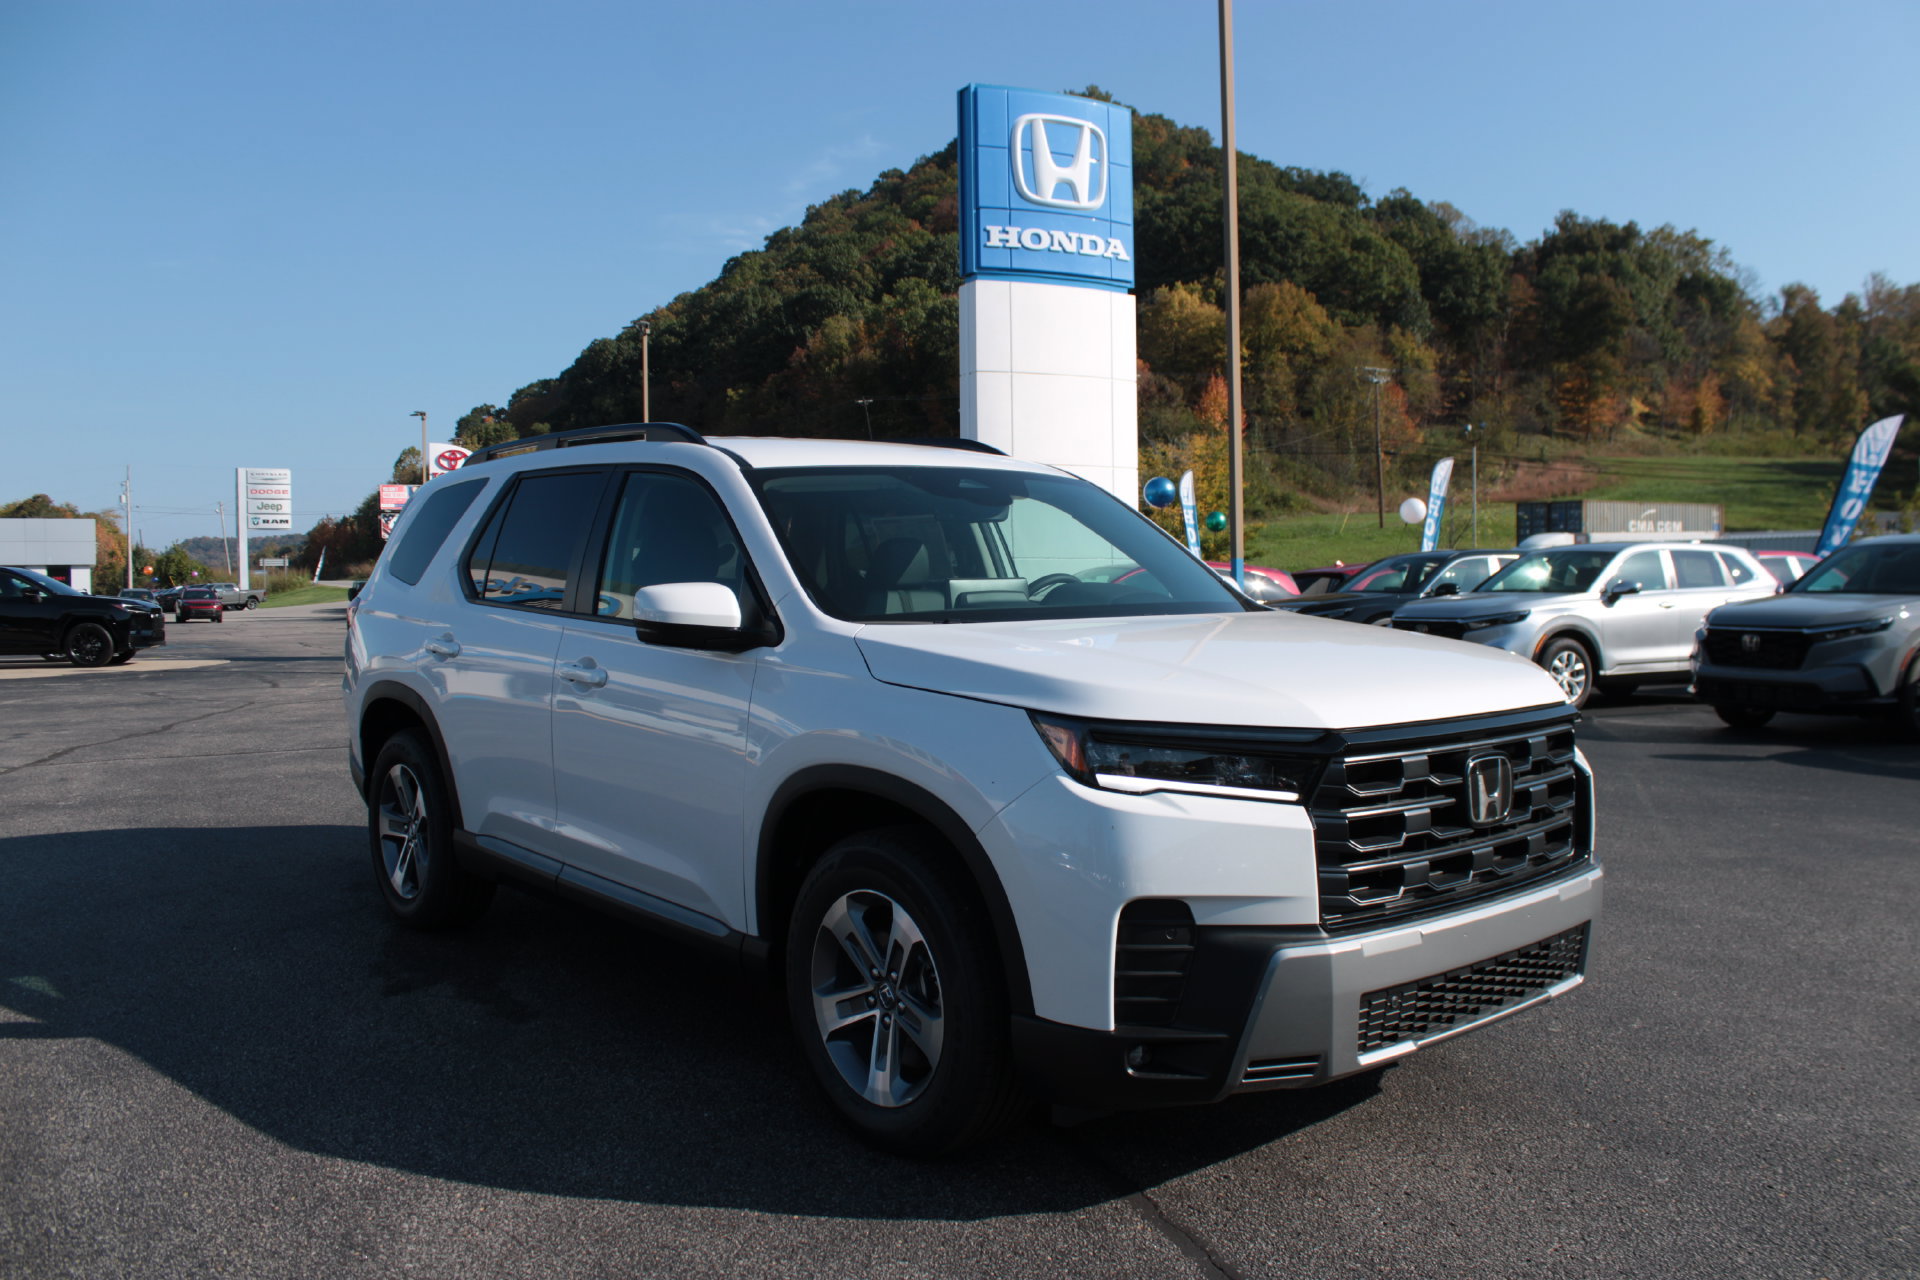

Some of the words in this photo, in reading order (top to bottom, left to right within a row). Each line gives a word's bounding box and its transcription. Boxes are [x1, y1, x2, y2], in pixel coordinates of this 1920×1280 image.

[985, 225, 1130, 261] HONDA
[256, 501, 283, 512] Jeep
[1628, 519, 1655, 532] CMA
